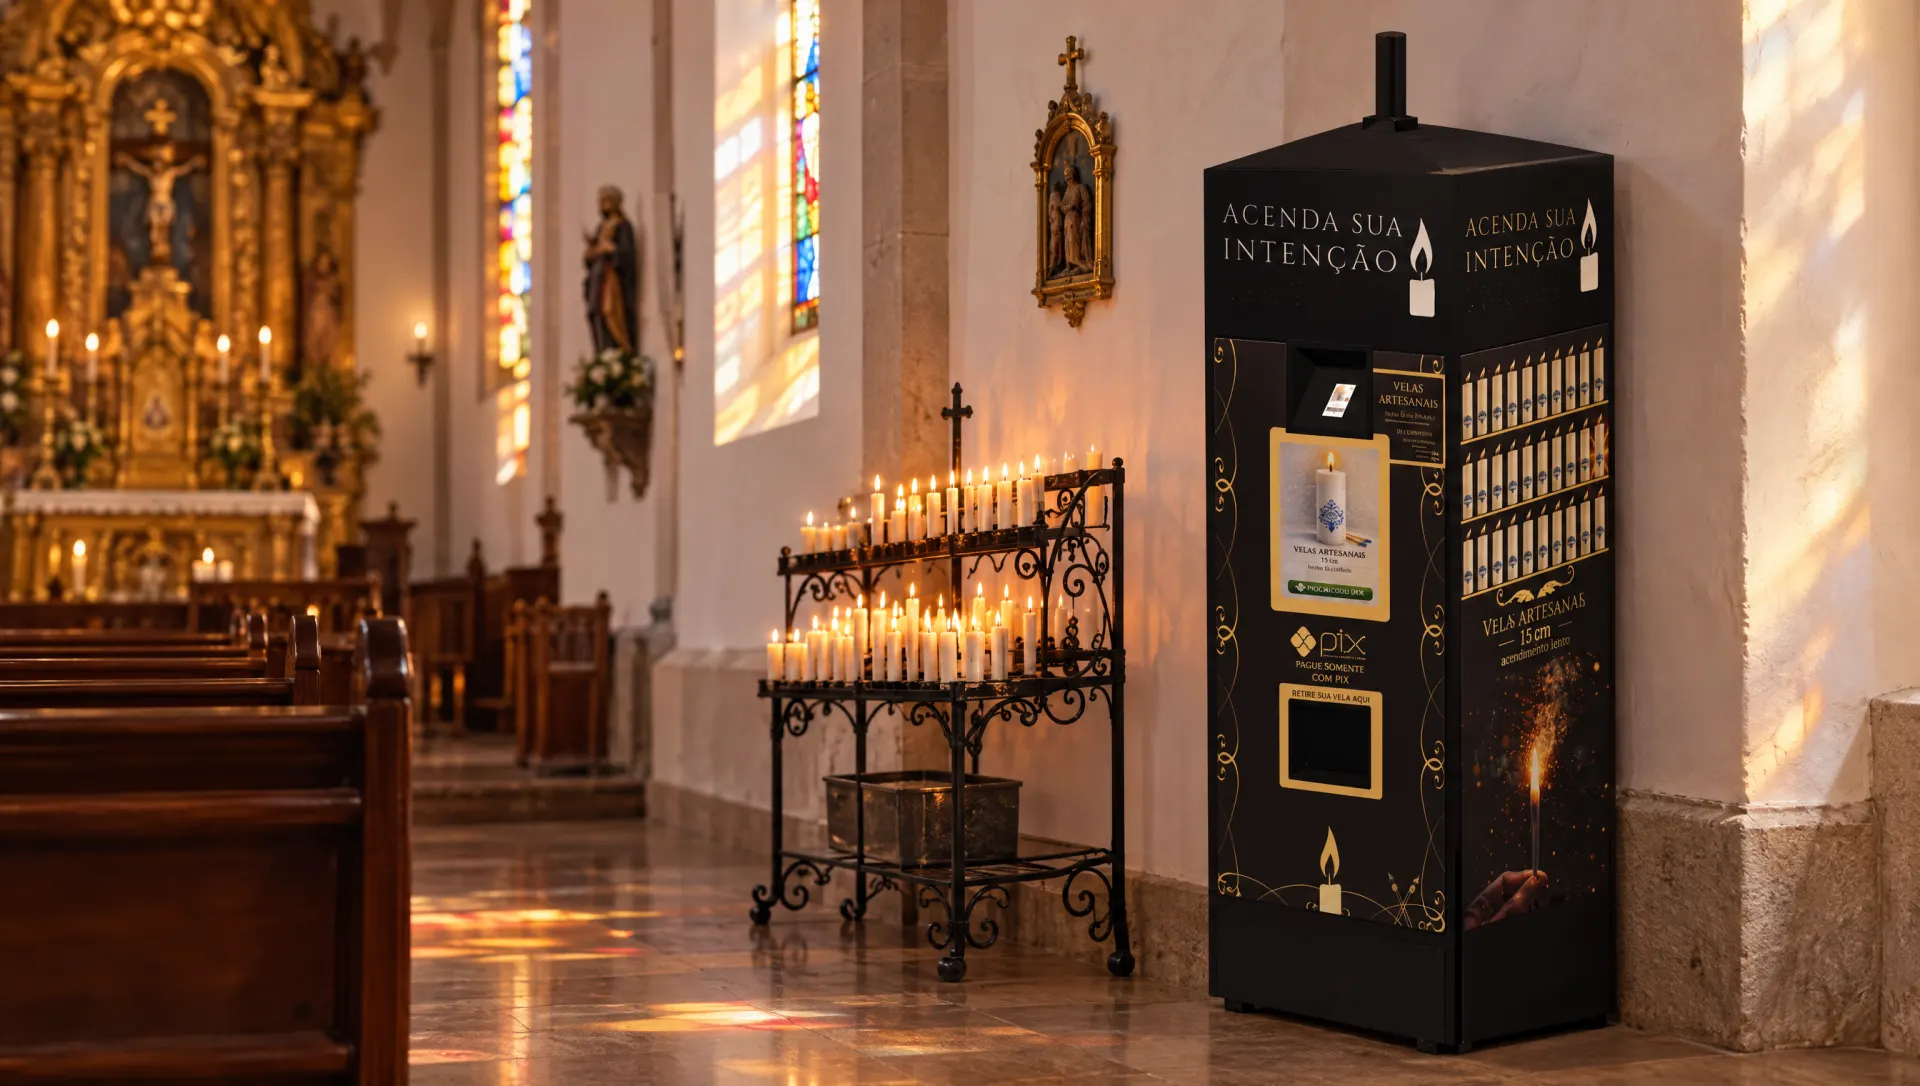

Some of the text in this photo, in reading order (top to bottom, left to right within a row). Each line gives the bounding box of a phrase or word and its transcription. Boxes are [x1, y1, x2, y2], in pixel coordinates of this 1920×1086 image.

[1223, 202, 1403, 238] ACENDA SUA
[1465, 207, 1576, 238] ACENDA SUA
[1223, 237, 1398, 274] INTENÇÃO
[1466, 236, 1574, 273] INTENÇÃO
[1393, 381, 1424, 393] VELAS
[1378, 394, 1439, 409] ARTESANAIS
[1293, 545, 1366, 559] VELAS ARTESANAIS
[1482, 613, 1516, 638] VELAS
[1320, 628, 1367, 658] pix
[1520, 625, 1551, 646] 15 cm
[1550, 636, 1571, 651] lento
[1295, 660, 1365, 674] PAGUE SOMENTE
[1311, 673, 1350, 684] COM PIX
[1292, 689, 1371, 704] RETIRE SUA VELA AQUI
